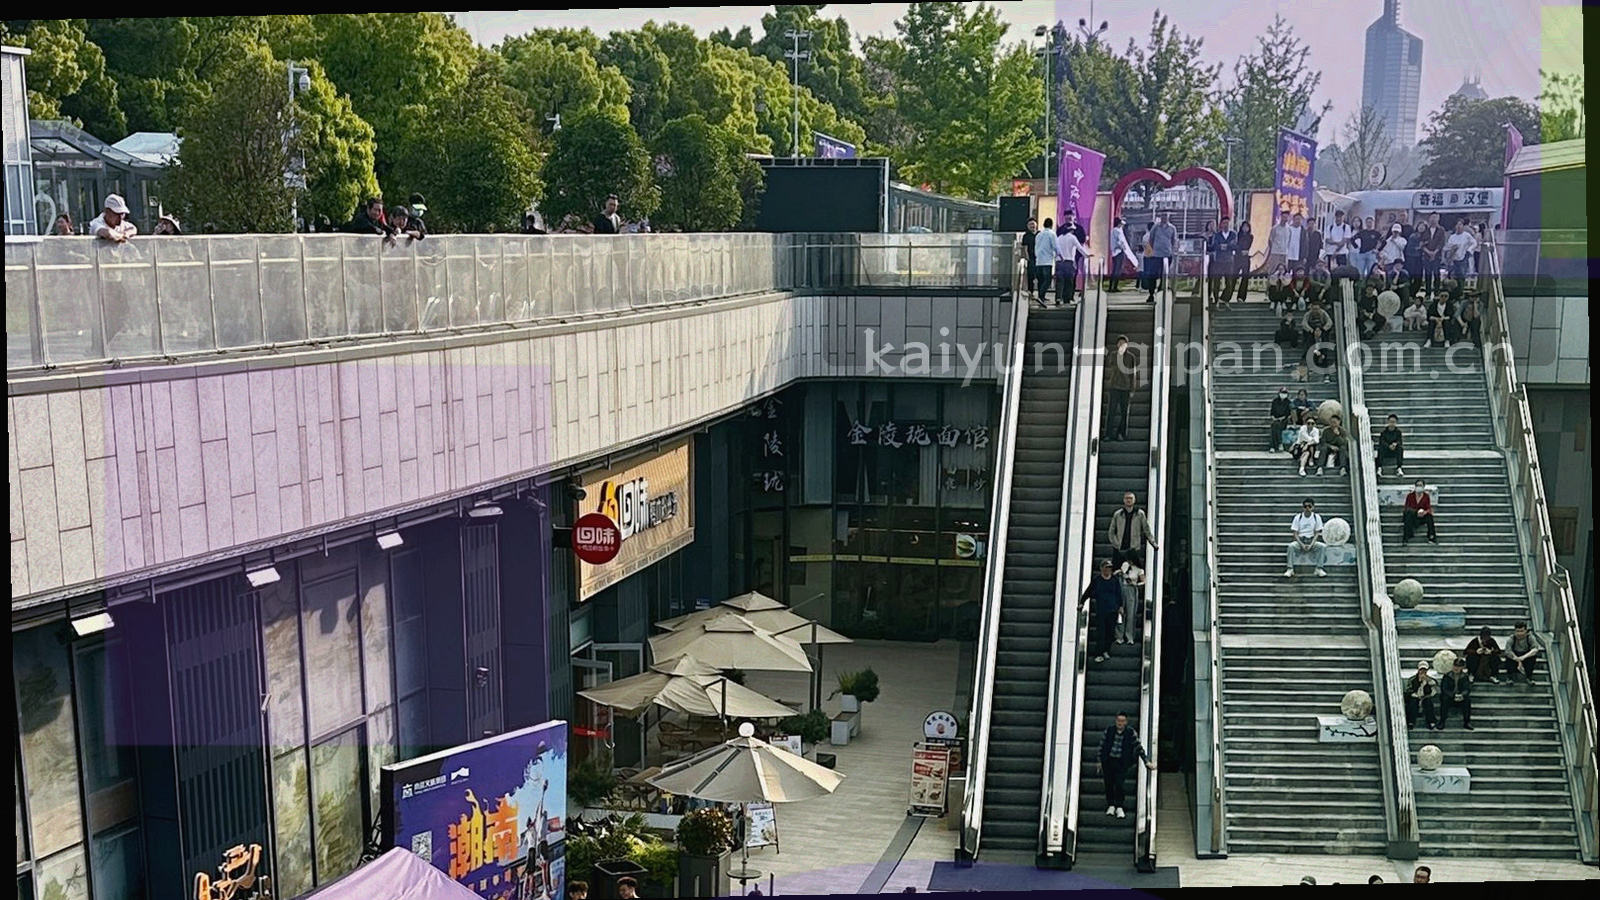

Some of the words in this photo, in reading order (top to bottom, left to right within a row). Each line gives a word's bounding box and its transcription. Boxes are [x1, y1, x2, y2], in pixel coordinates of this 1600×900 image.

[1463, 191, 1489, 205] 汉堡
[576, 527, 615, 545] 回味
[448, 789, 518, 880] 潮南
